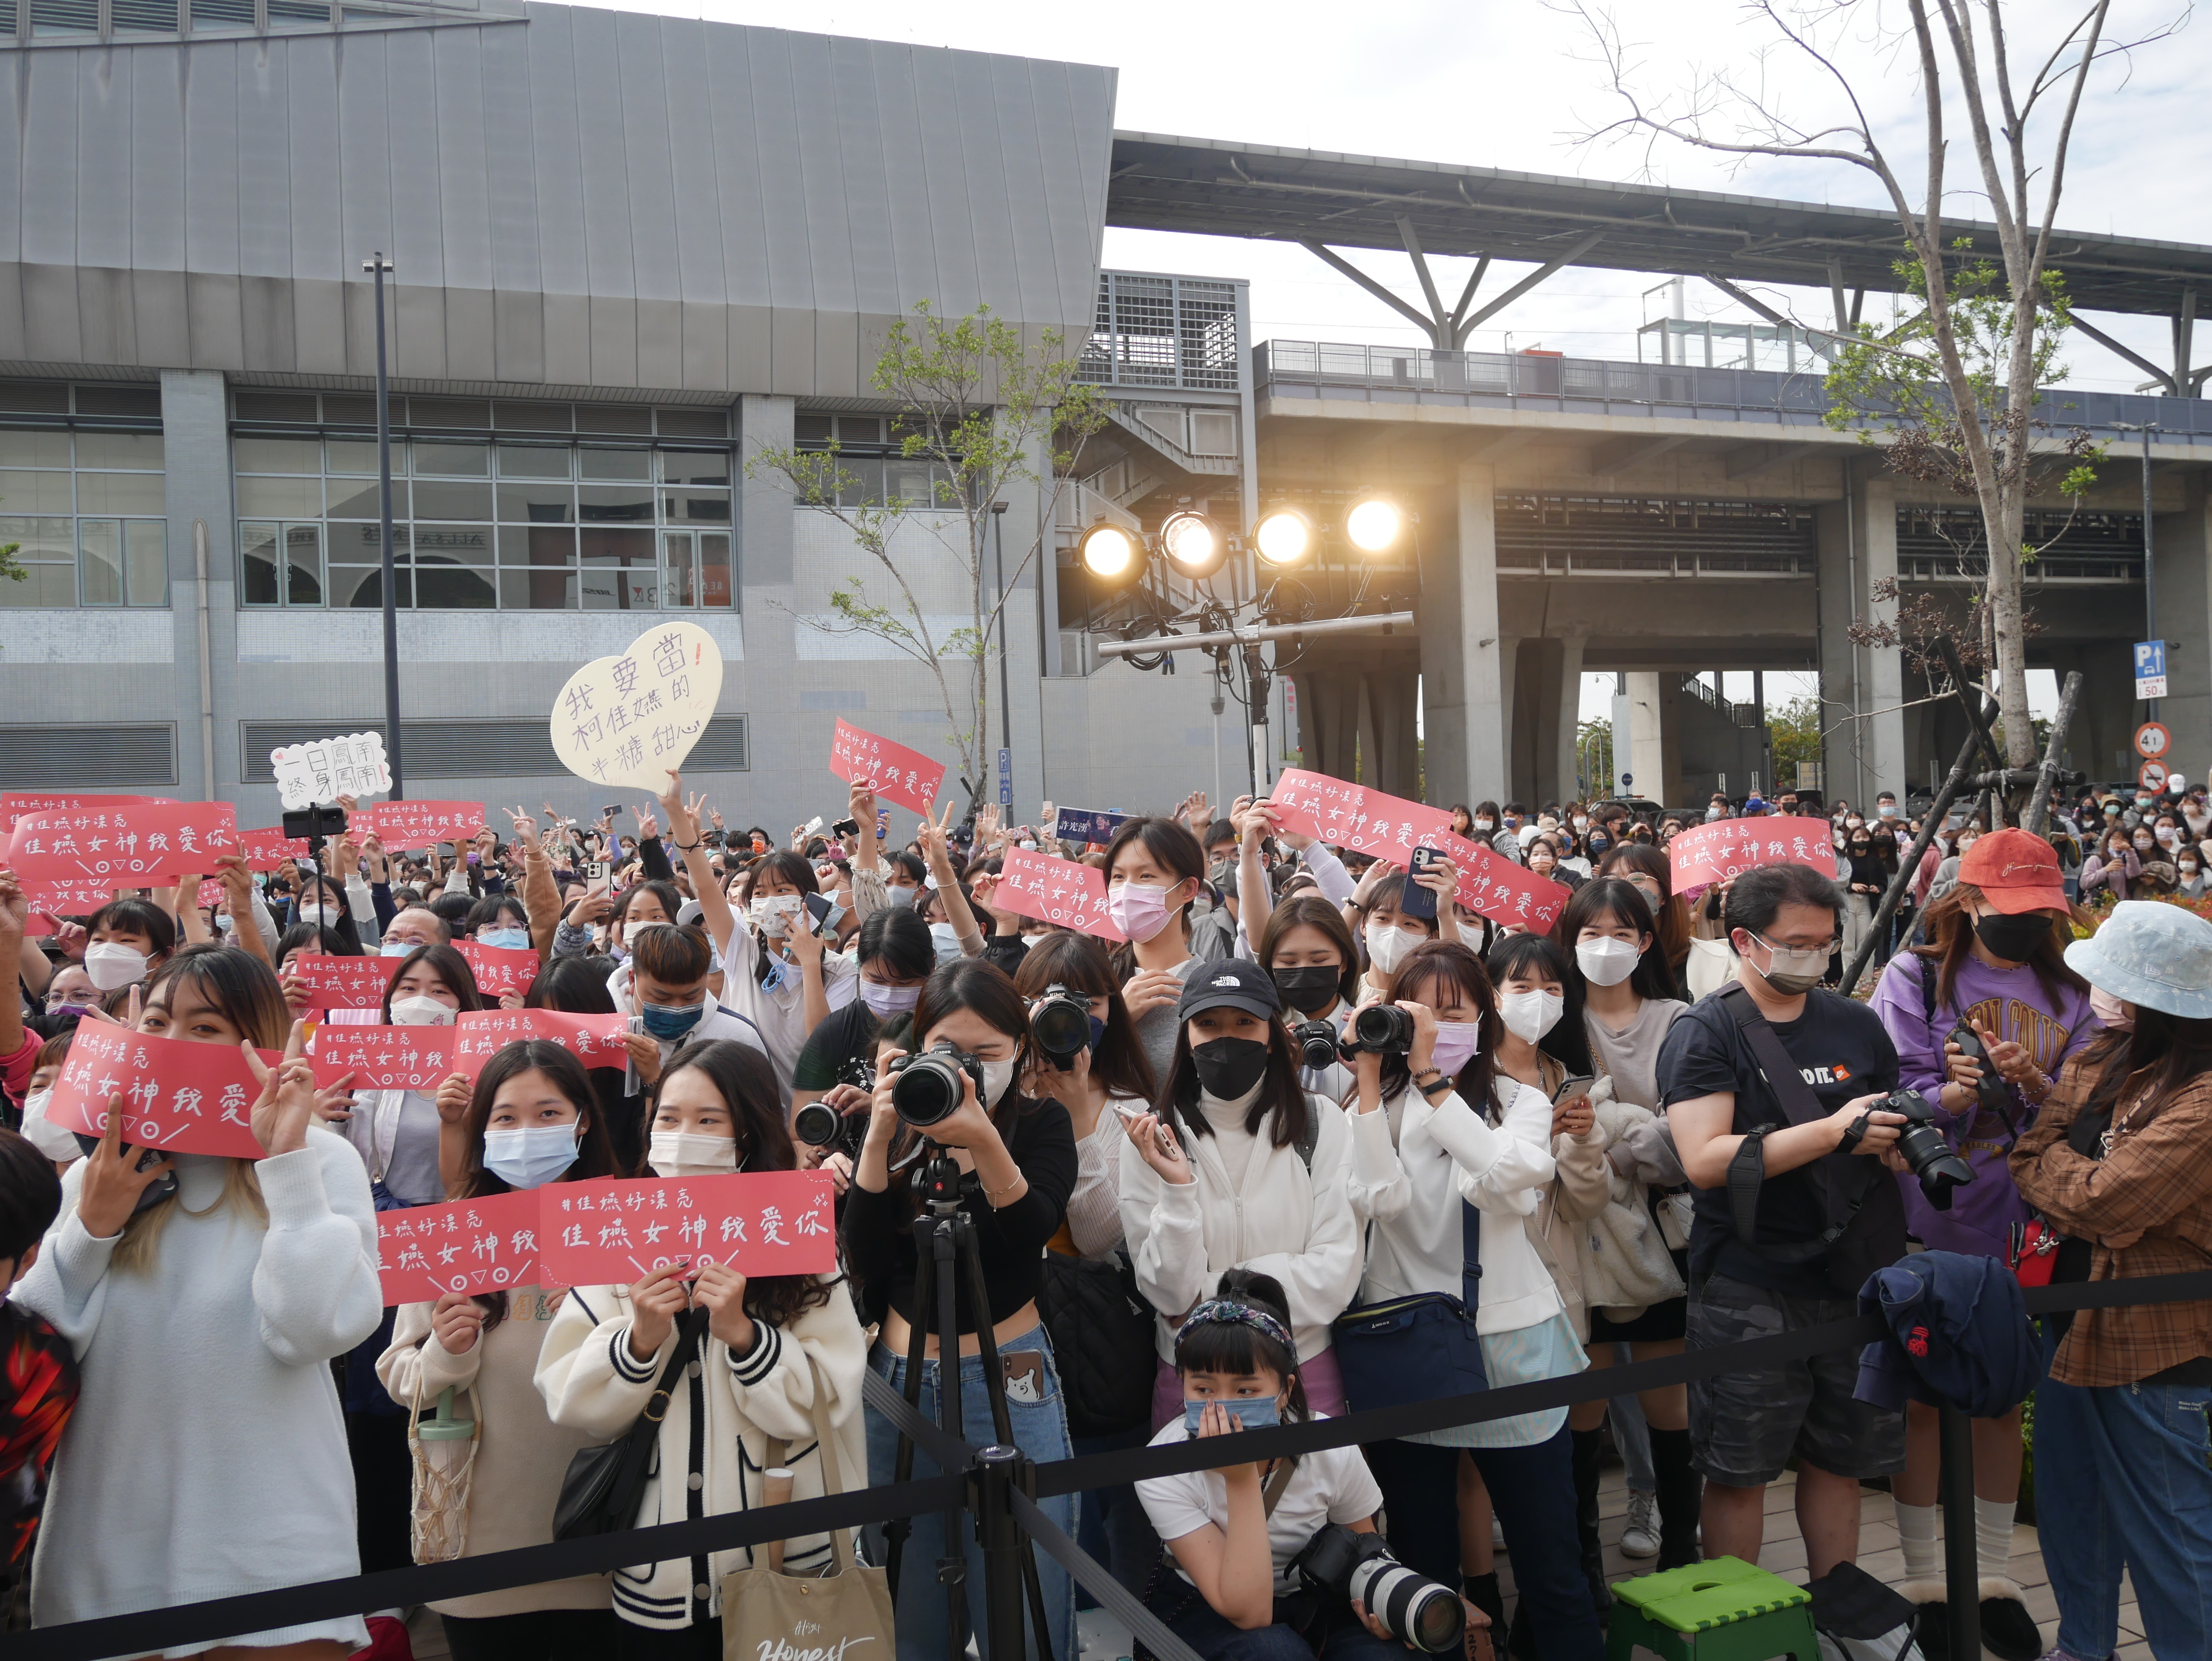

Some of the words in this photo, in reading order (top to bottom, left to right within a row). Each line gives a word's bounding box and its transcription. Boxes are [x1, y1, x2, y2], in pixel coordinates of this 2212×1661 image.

[2137, 646, 2151, 667] P
[2146, 686, 2157, 696] 50
[285, 741, 374, 772] 一日鳳南
[592, 720, 700, 780] 半糖甜心
[1059, 820, 1087, 833] 許光漢
[563, 1206, 829, 1249] 佳嬿女神我愛你
